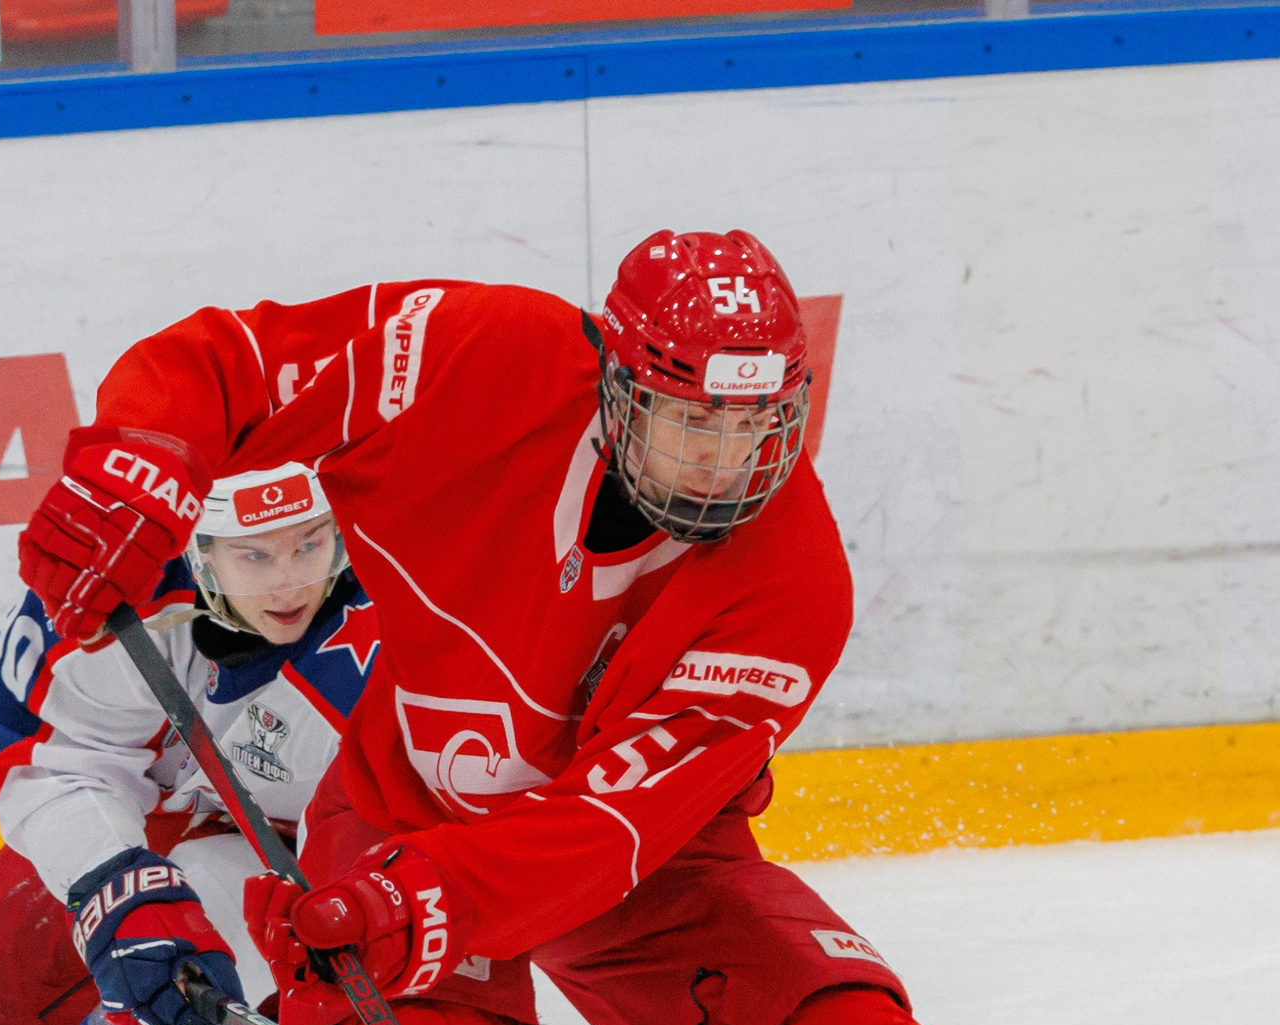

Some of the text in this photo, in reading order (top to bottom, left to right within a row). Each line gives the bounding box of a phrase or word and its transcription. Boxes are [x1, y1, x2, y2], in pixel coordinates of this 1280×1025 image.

[708, 276, 761, 315] 54
[710, 380, 778, 391] OLIMPBET
[103, 448, 205, 522] СПАР
[242, 498, 309, 523] OLIMPBET
